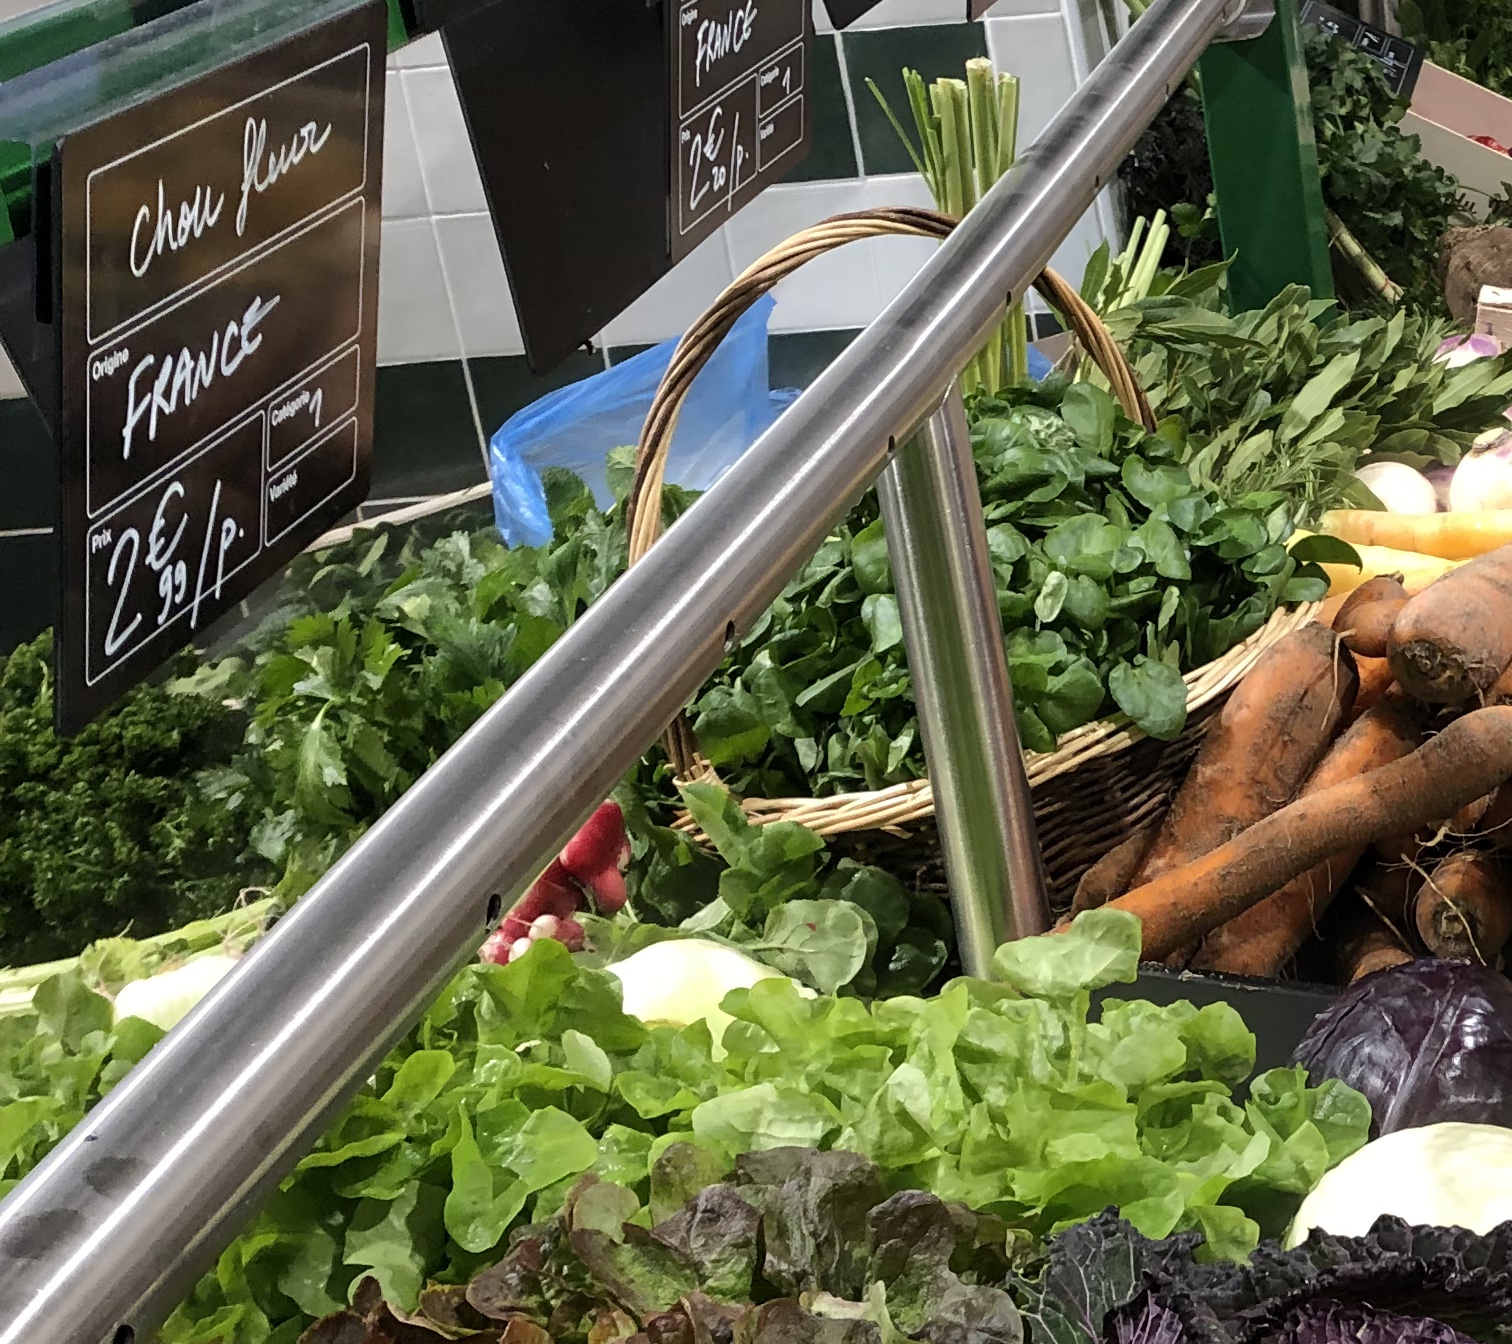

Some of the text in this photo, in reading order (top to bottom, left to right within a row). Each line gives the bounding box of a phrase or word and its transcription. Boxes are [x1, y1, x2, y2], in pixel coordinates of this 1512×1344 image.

[130, 116, 332, 279] Chou fleur
[92, 347, 129, 381] Origine
[121, 295, 281, 459] FRANCE
[309, 387, 323, 429] 1
[91, 528, 112, 554] Prix
